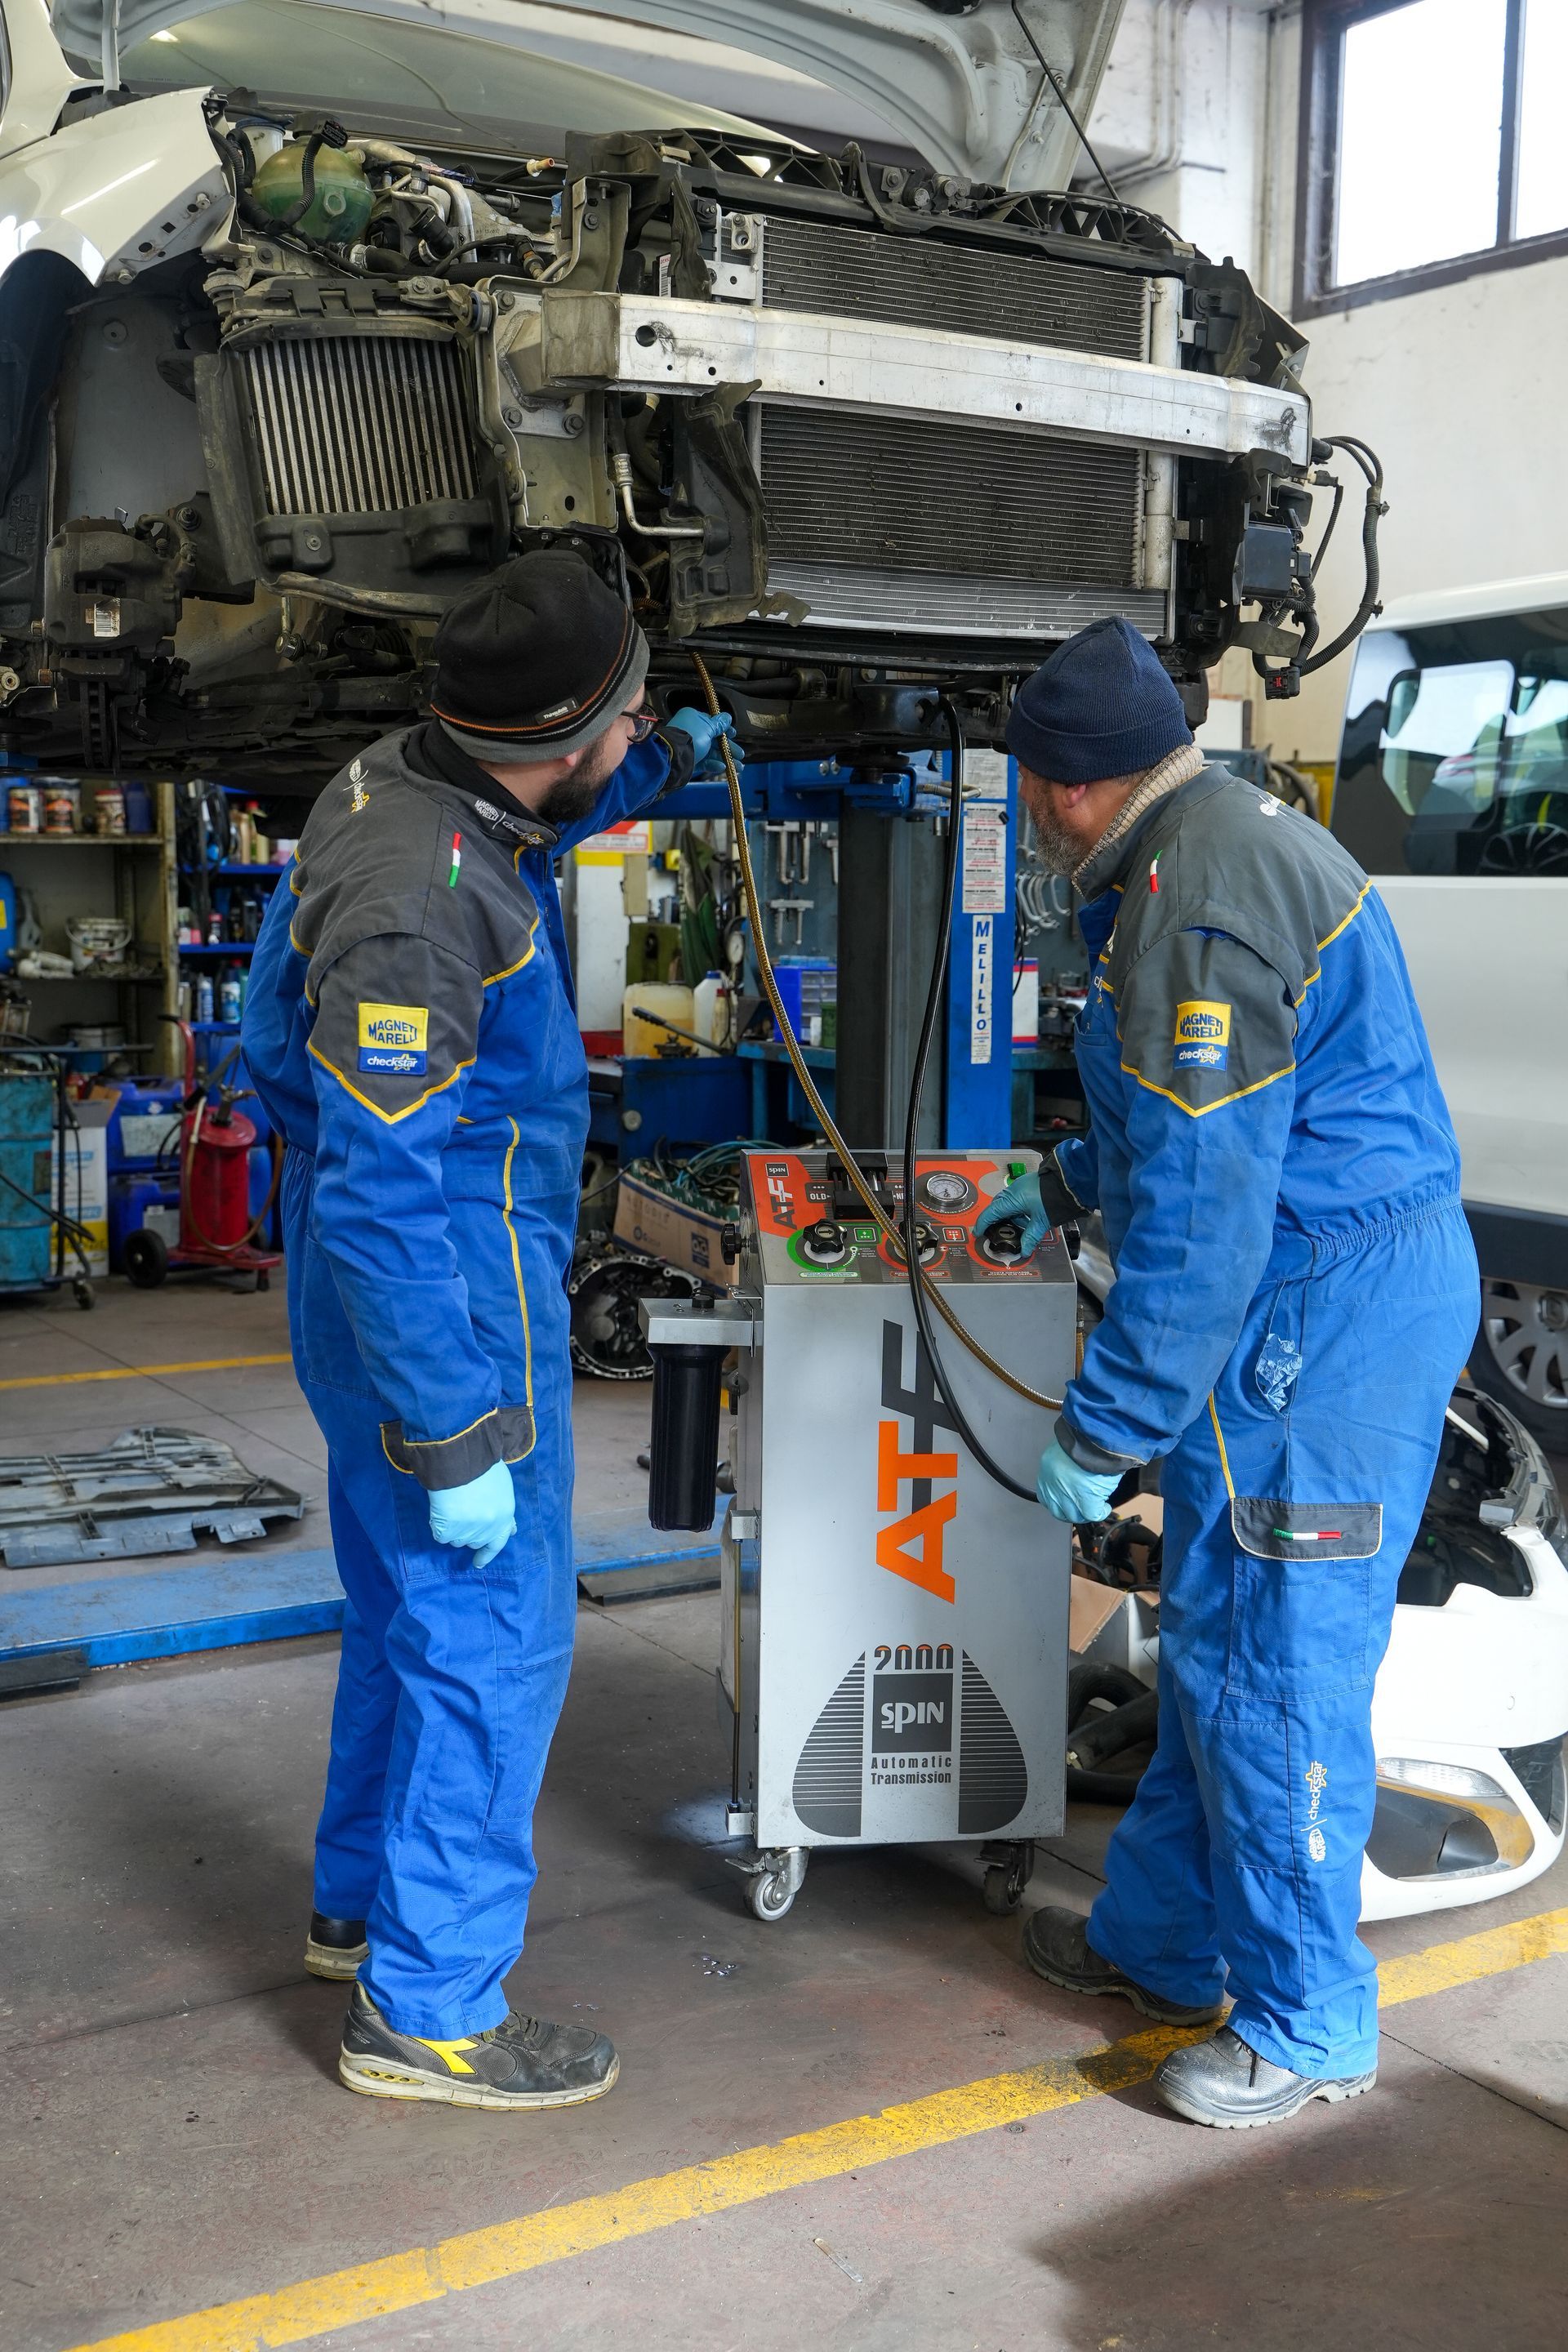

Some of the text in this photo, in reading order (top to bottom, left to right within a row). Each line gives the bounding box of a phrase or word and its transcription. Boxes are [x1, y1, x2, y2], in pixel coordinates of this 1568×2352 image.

[975, 920, 991, 1031] MELILLO
[368, 1018, 418, 1034] MAGNETI
[368, 1031, 418, 1045] MARELLI
[367, 1055, 418, 1068] checkstar
[1178, 1048, 1222, 1062] checkstar
[809, 1192, 826, 1200] OLD
[767, 1178, 797, 1230] ATF
[876, 1319, 960, 1605] ATF
[874, 1643, 954, 1671] 2000
[871, 1755, 952, 1770] Automatic
[871, 1771, 952, 1785] Transmission
[1307, 1761, 1323, 1821] checkstar
